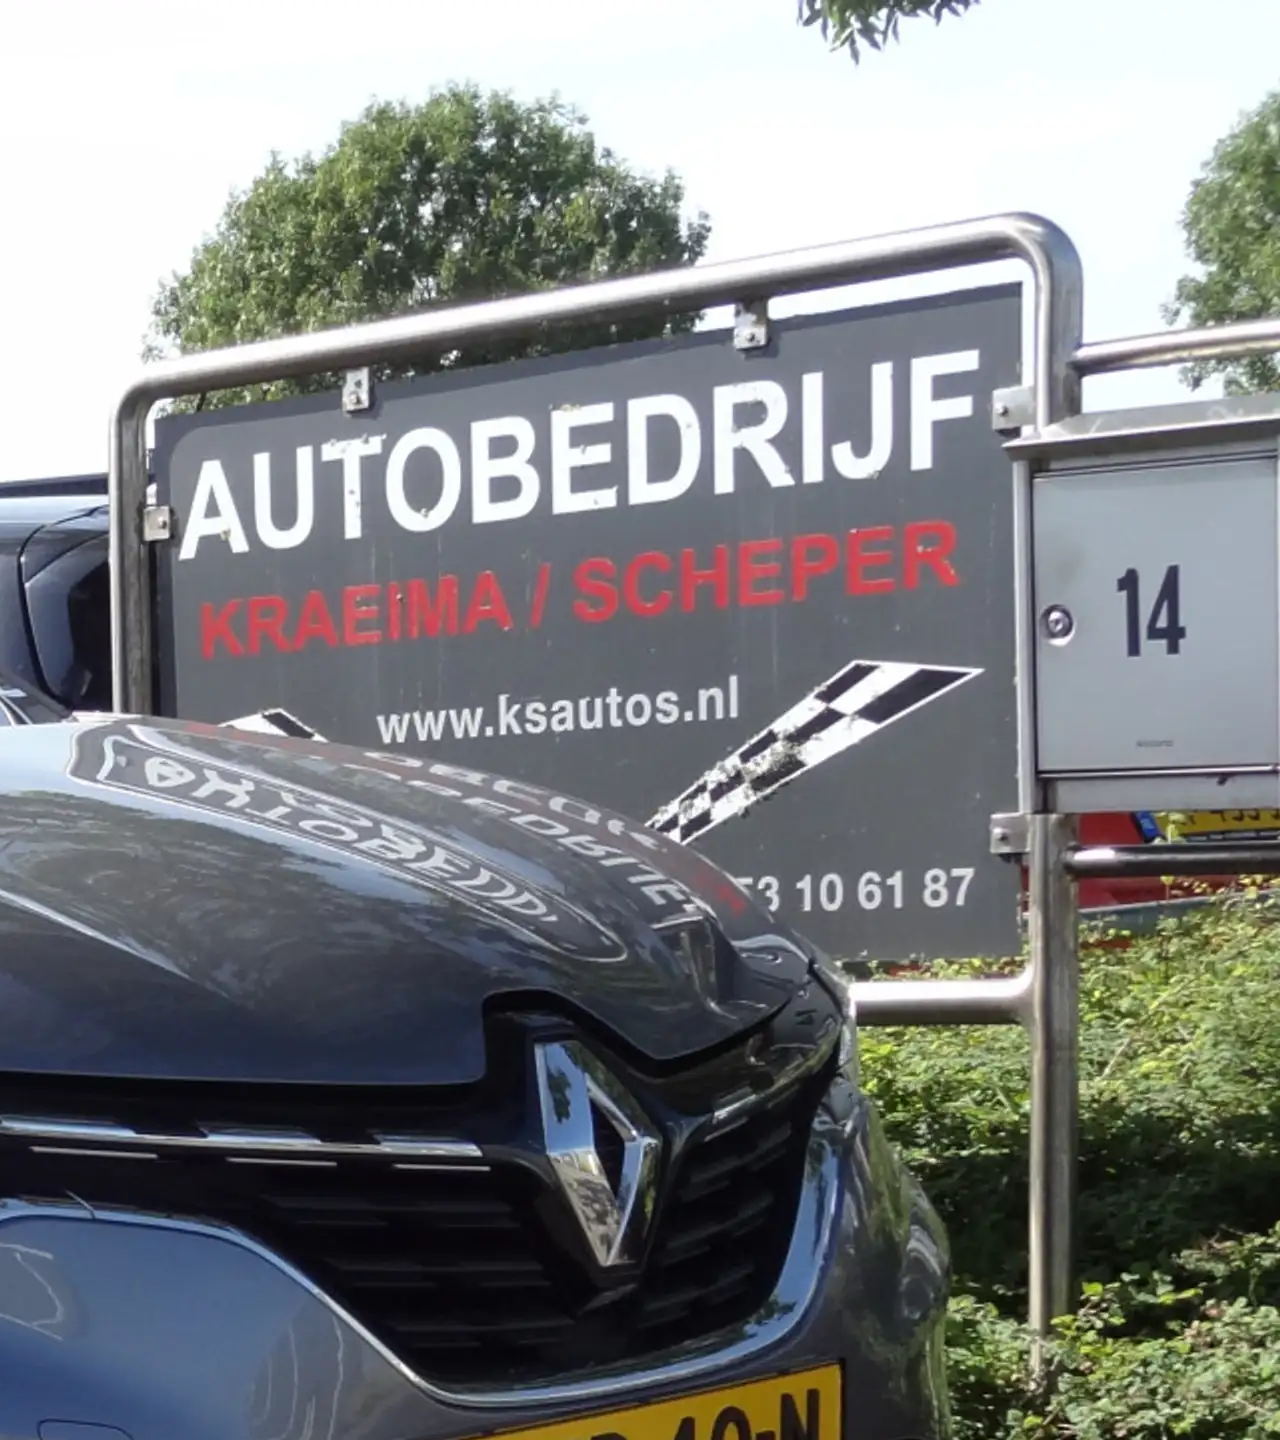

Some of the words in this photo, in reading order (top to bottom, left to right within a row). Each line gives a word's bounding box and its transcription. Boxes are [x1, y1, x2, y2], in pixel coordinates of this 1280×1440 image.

[179, 350, 980, 560] AUTOBEDRIJF
[200, 569, 513, 661] KRAEIMA
[531, 563, 552, 628] /
[573, 519, 960, 623] SCHEPER
[1117, 564, 1186, 658] 14
[376, 675, 739, 745] www.ksautos.nl
[795, 873, 844, 912] 10
[857, 870, 904, 910] 61
[922, 866, 976, 909] 87
